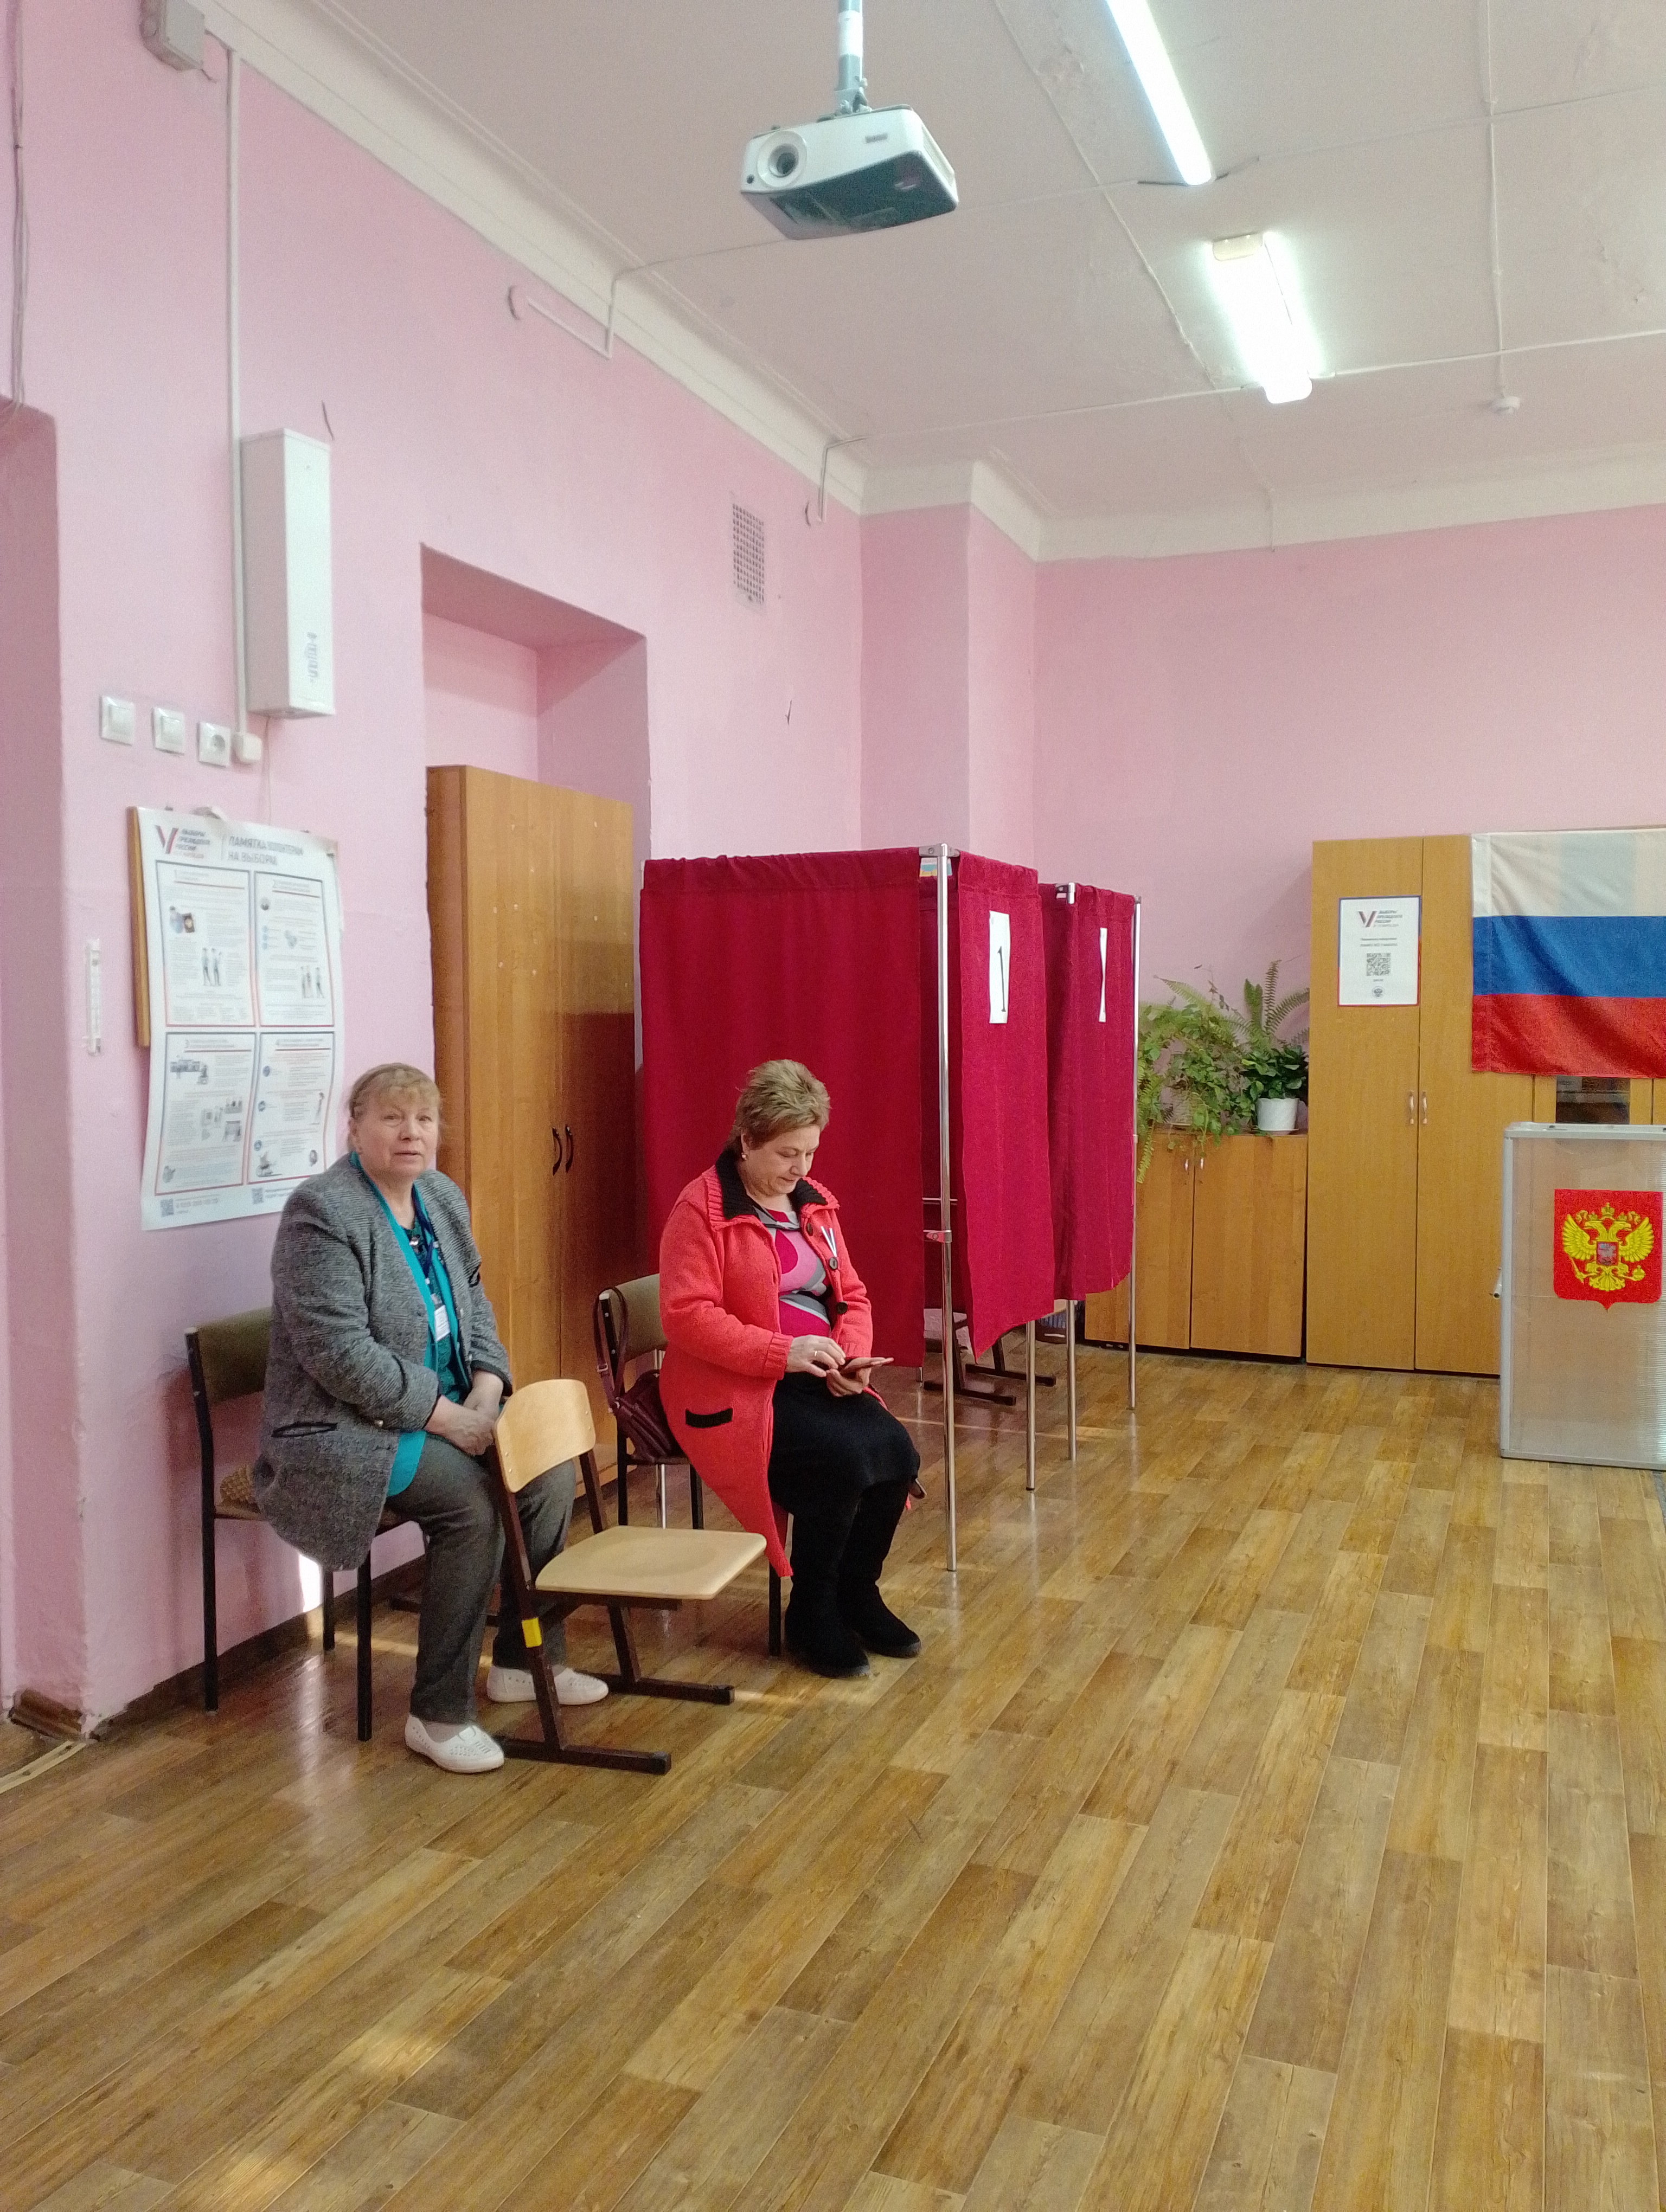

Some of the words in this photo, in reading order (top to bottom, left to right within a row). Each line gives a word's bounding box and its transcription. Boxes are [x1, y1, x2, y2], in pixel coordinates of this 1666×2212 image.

[228, 835, 266, 849] ПАМЯТКА
[228, 851, 239, 861] НА
[997, 946, 1007, 1013] 1
